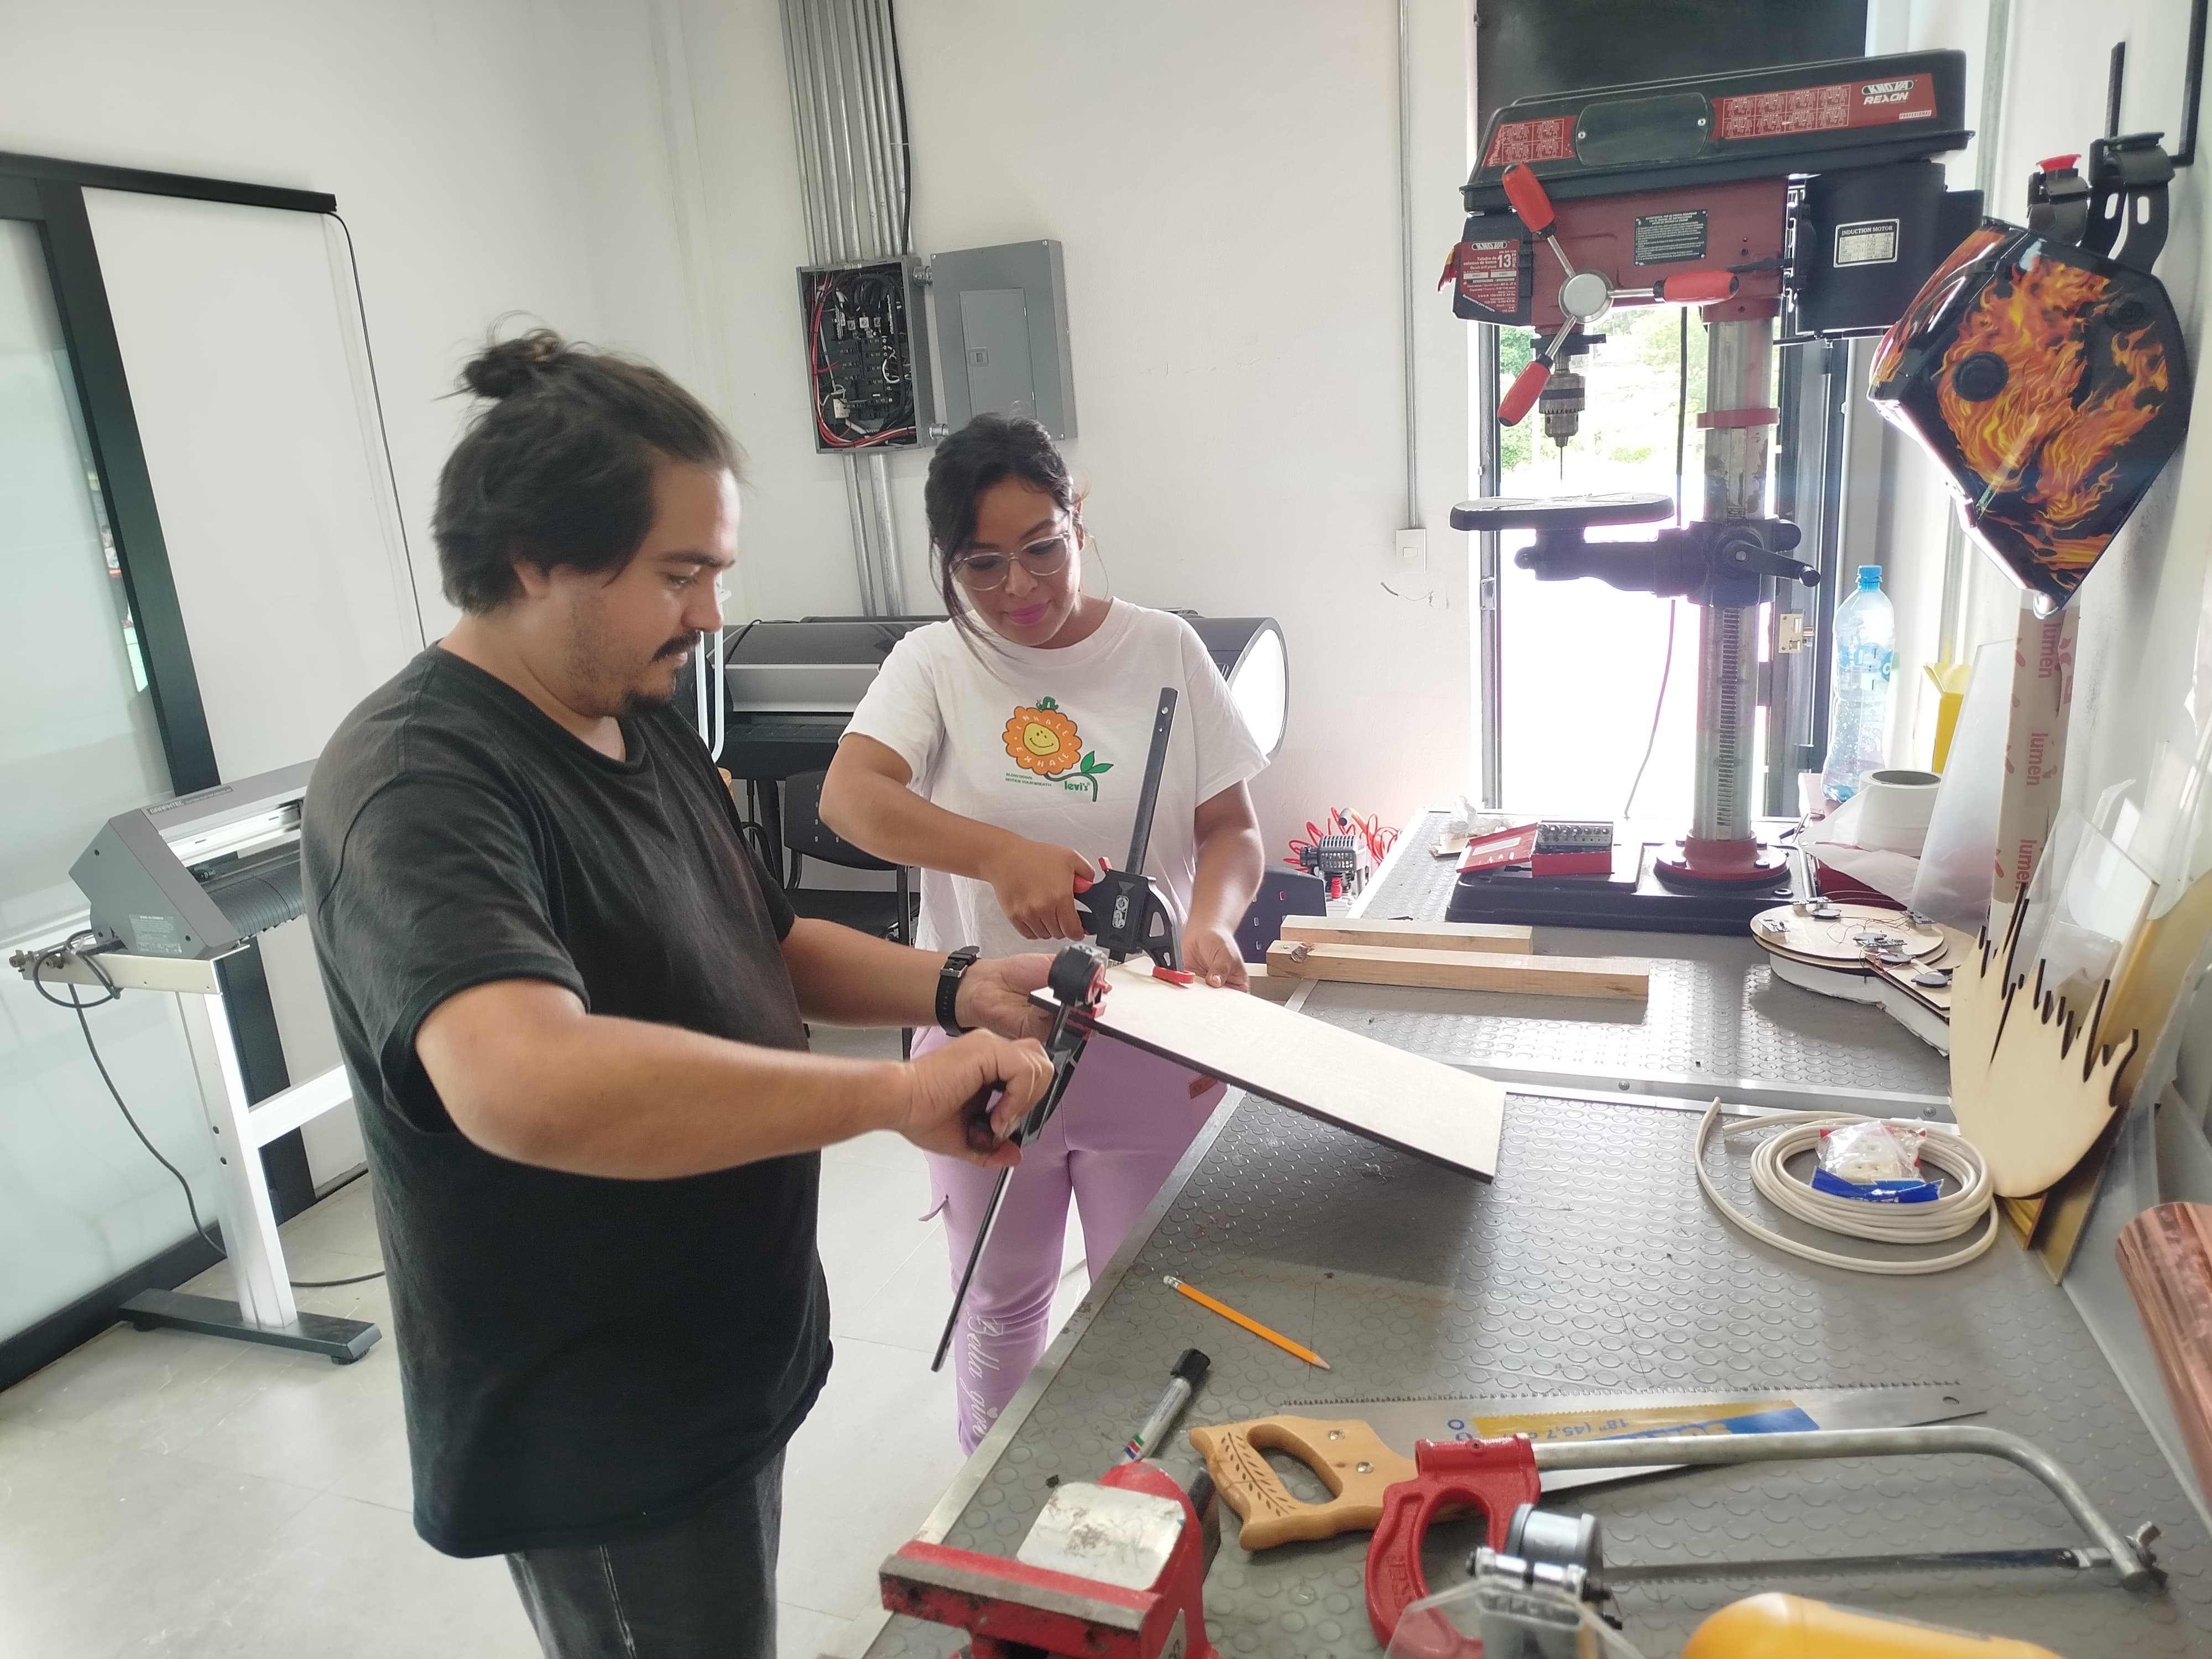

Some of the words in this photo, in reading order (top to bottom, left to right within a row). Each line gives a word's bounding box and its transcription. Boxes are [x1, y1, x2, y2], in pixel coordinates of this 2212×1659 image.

[1863, 92, 1909, 105] REXON
[1841, 227, 1872, 236] INDUCTION
[2038, 623, 2061, 679] lumen
[1016, 715, 1069, 737] INHALE
[1016, 747, 1069, 767] EXHALE
[2026, 733, 2048, 786] lumen
